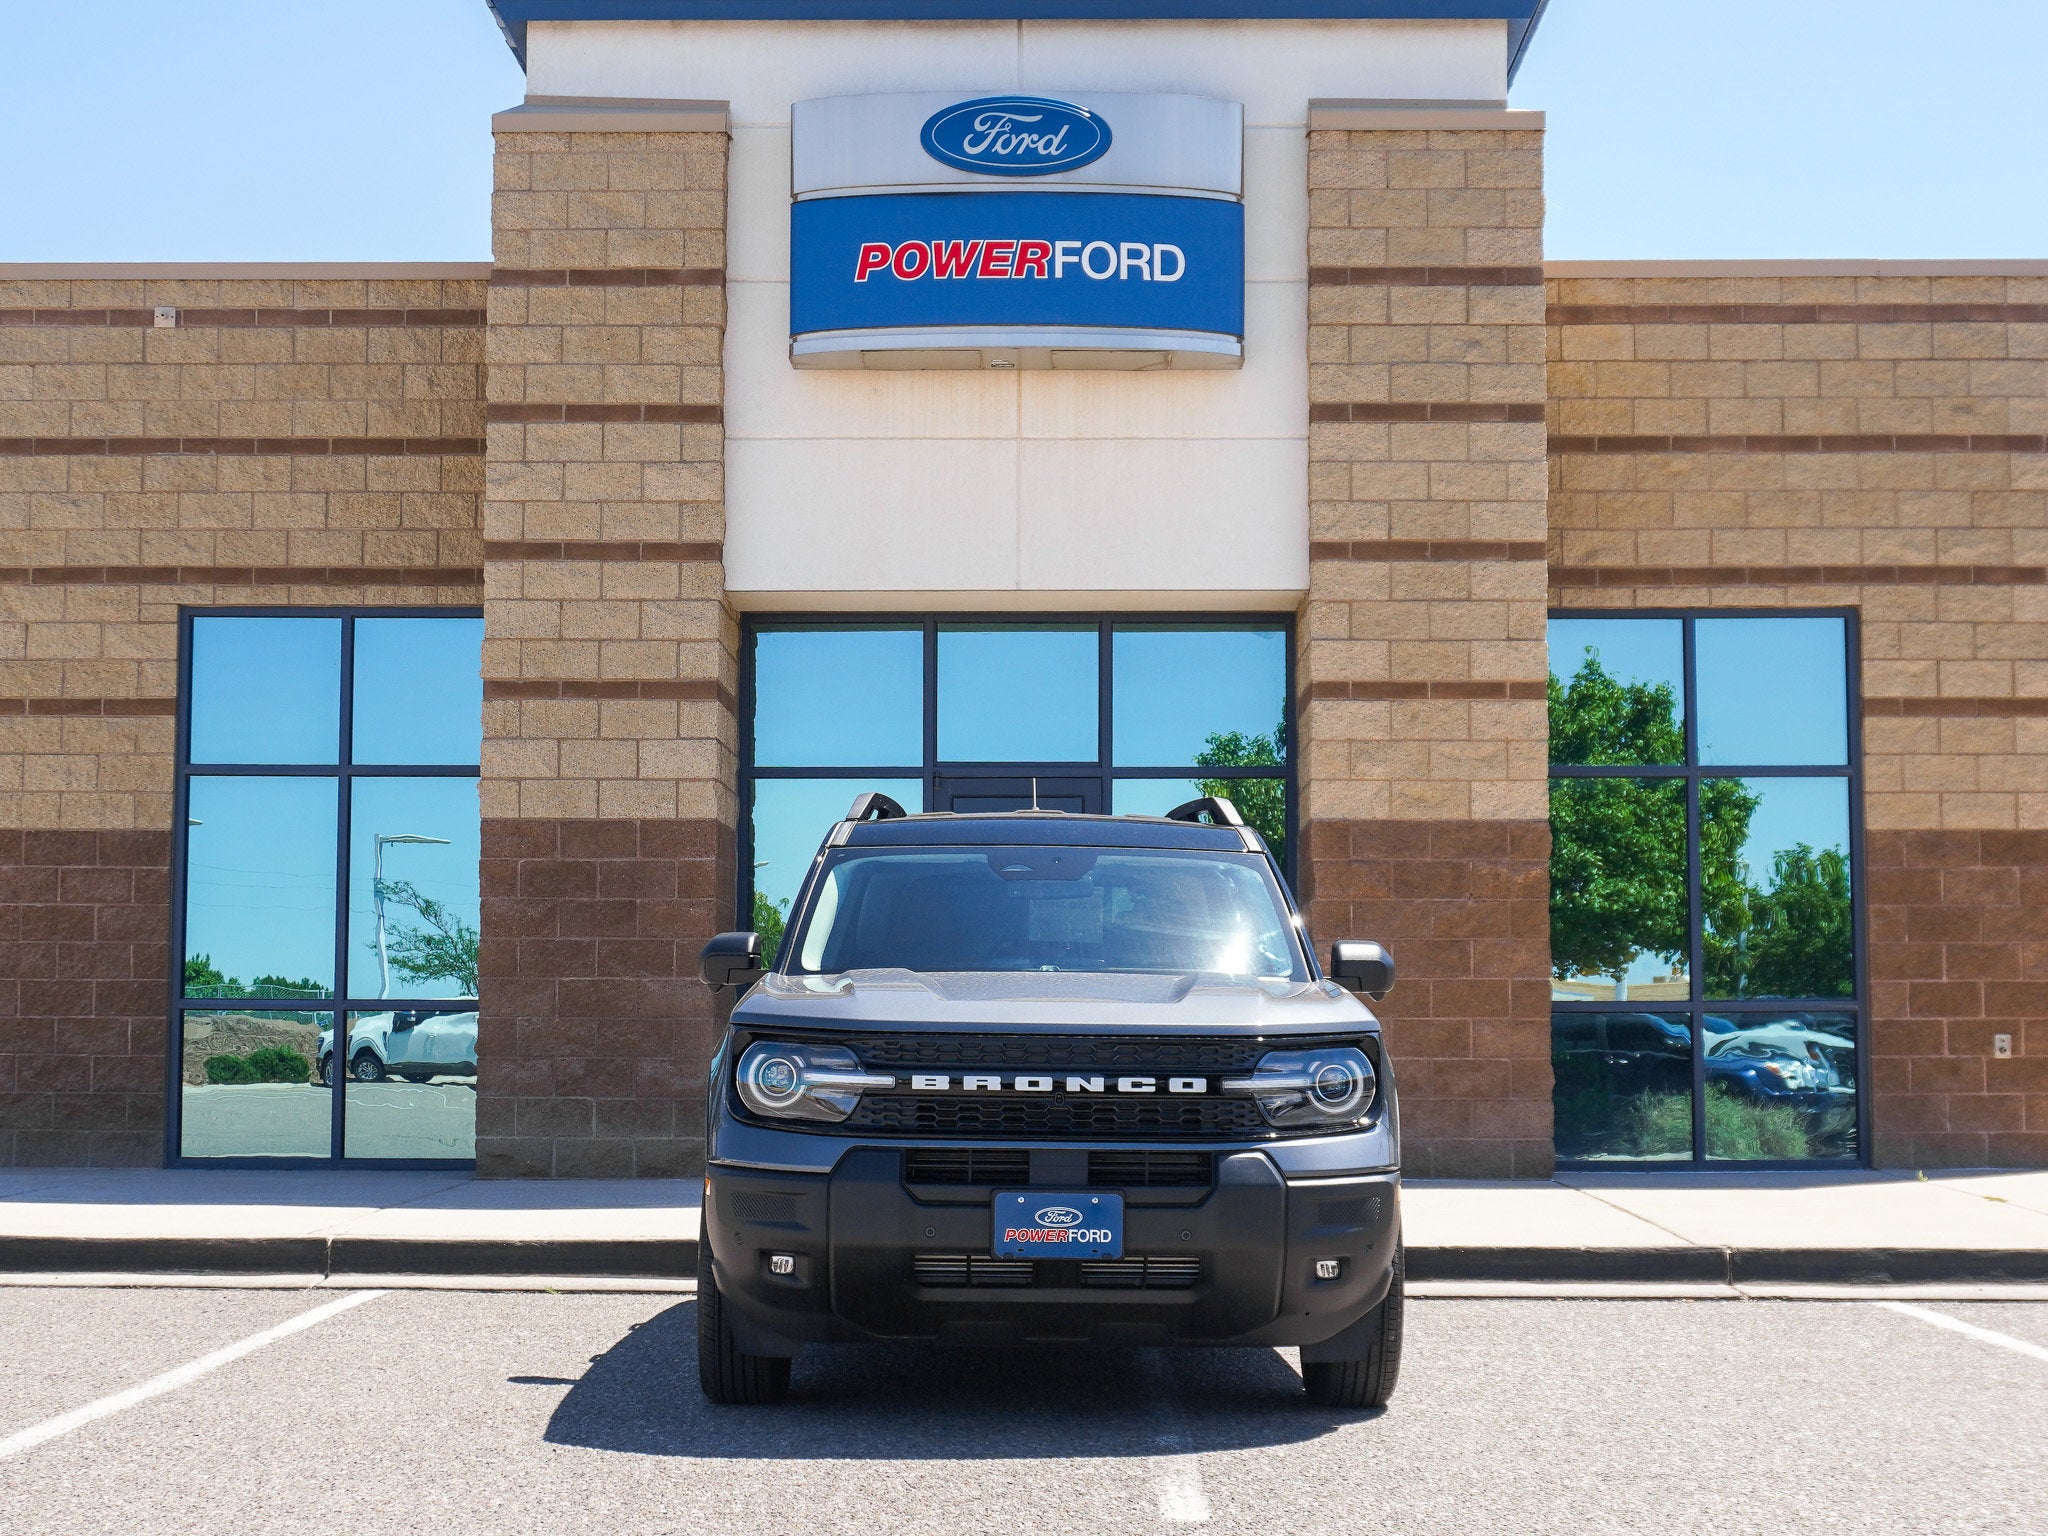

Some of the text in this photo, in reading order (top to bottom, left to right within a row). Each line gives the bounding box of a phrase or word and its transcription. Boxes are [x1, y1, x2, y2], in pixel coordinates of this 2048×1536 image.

[963, 111, 1069, 155] Ford
[911, 1075, 1207, 1093] BRONCO
[1044, 1210, 1073, 1223] Ford
